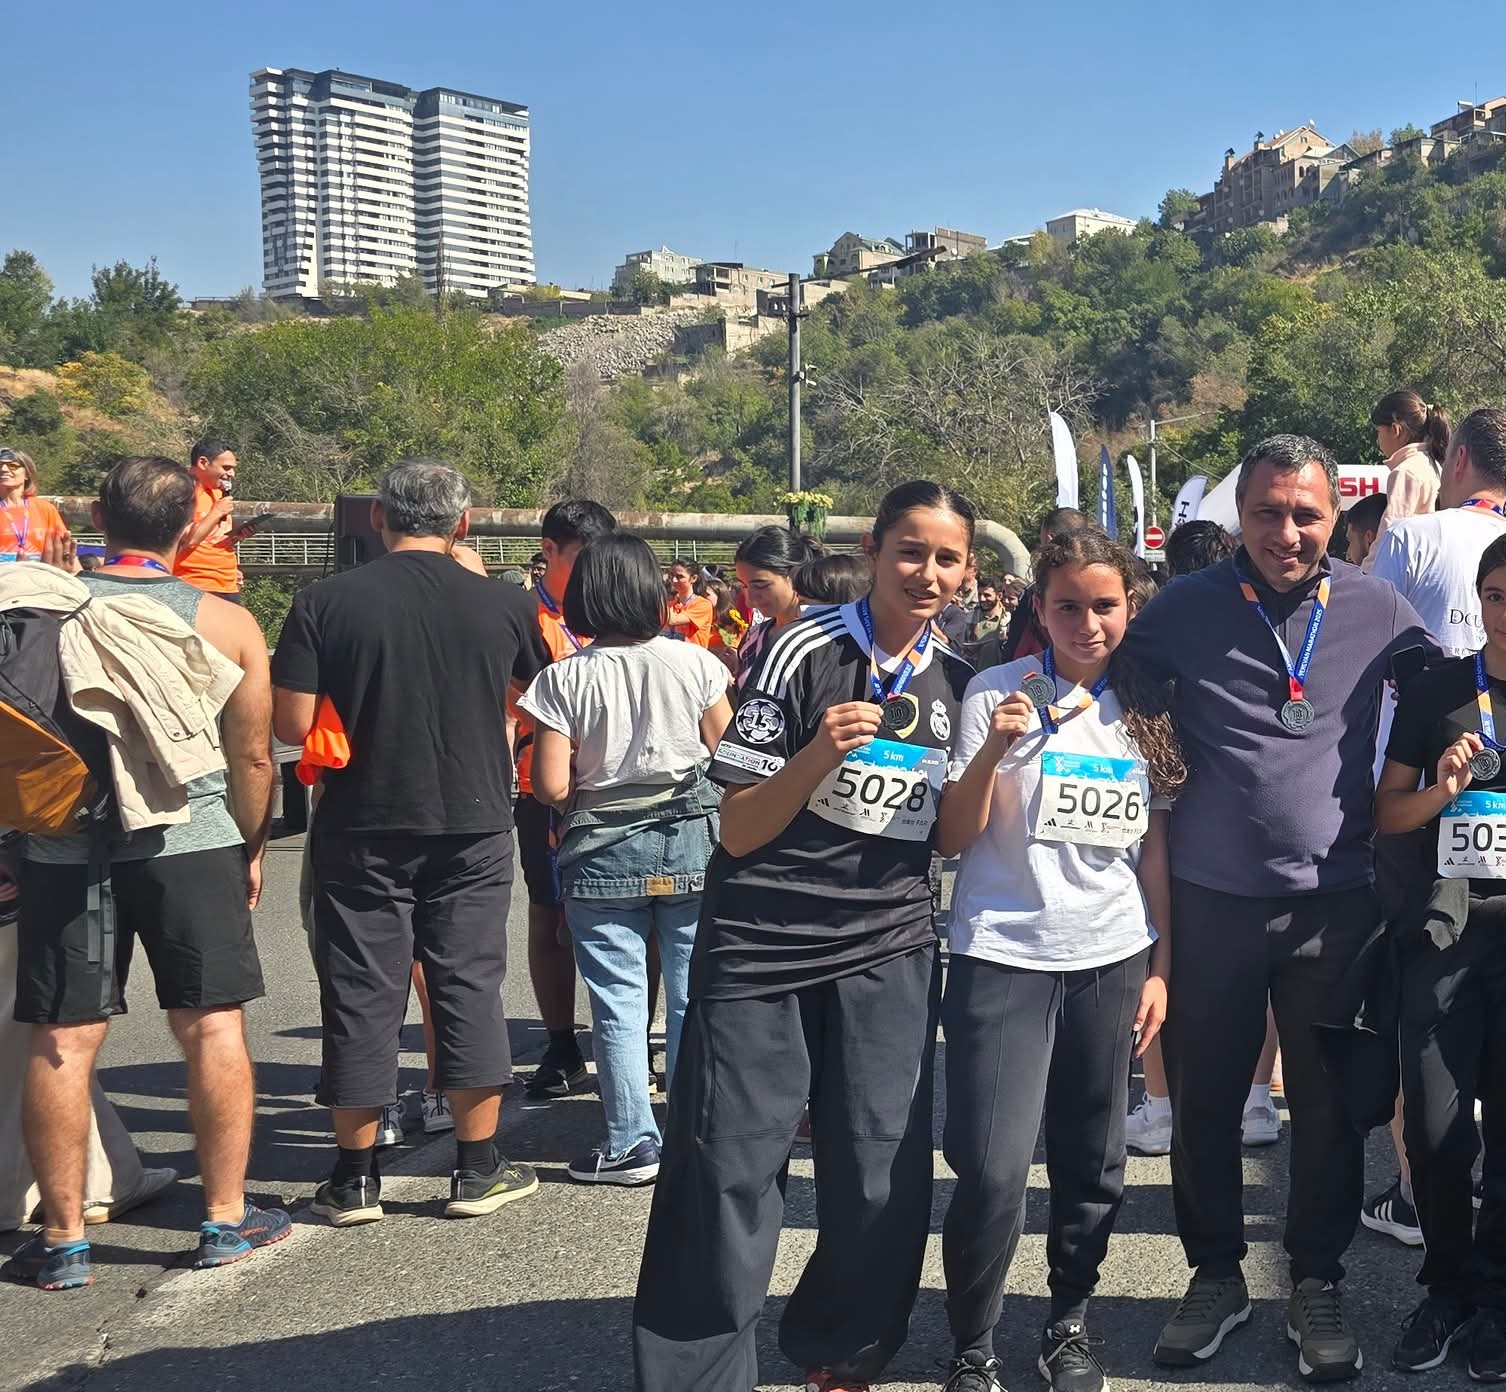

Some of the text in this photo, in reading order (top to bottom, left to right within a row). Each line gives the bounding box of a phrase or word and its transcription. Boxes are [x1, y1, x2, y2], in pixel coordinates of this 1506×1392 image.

[1305, 621, 1319, 652] MARATHON
[748, 711, 771, 731] 15
[883, 750, 904, 762] 5 km
[831, 766, 928, 813] 5028
[1057, 783, 1140, 822] 5026
[1485, 800, 1506, 809] 5 km
